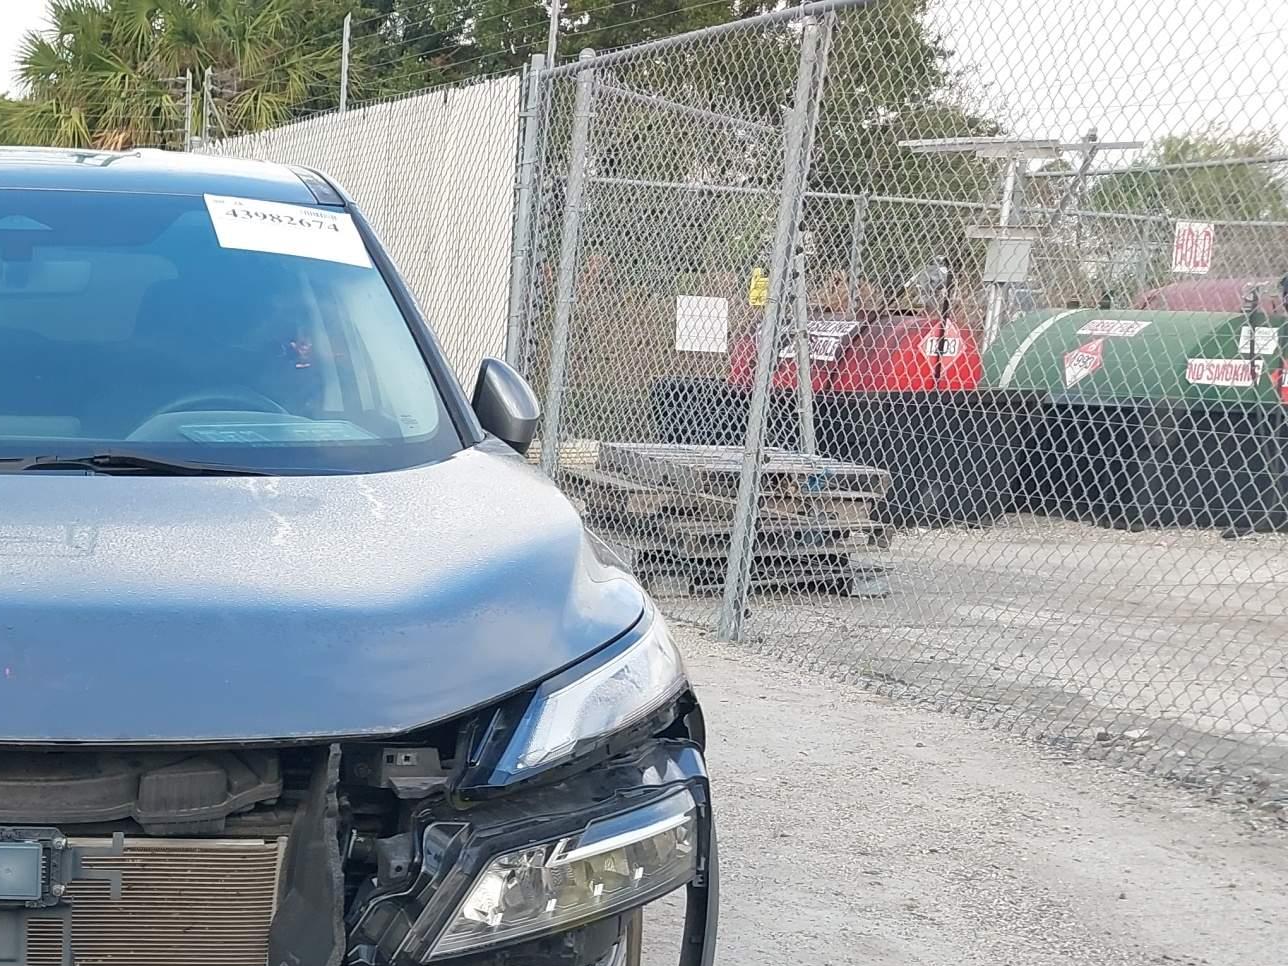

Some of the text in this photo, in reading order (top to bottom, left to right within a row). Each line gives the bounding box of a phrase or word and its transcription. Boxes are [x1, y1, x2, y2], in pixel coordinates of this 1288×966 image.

[225, 208, 340, 232] 43982674
[1175, 228, 1211, 267] HOLD
[1188, 363, 1204, 380] NO
